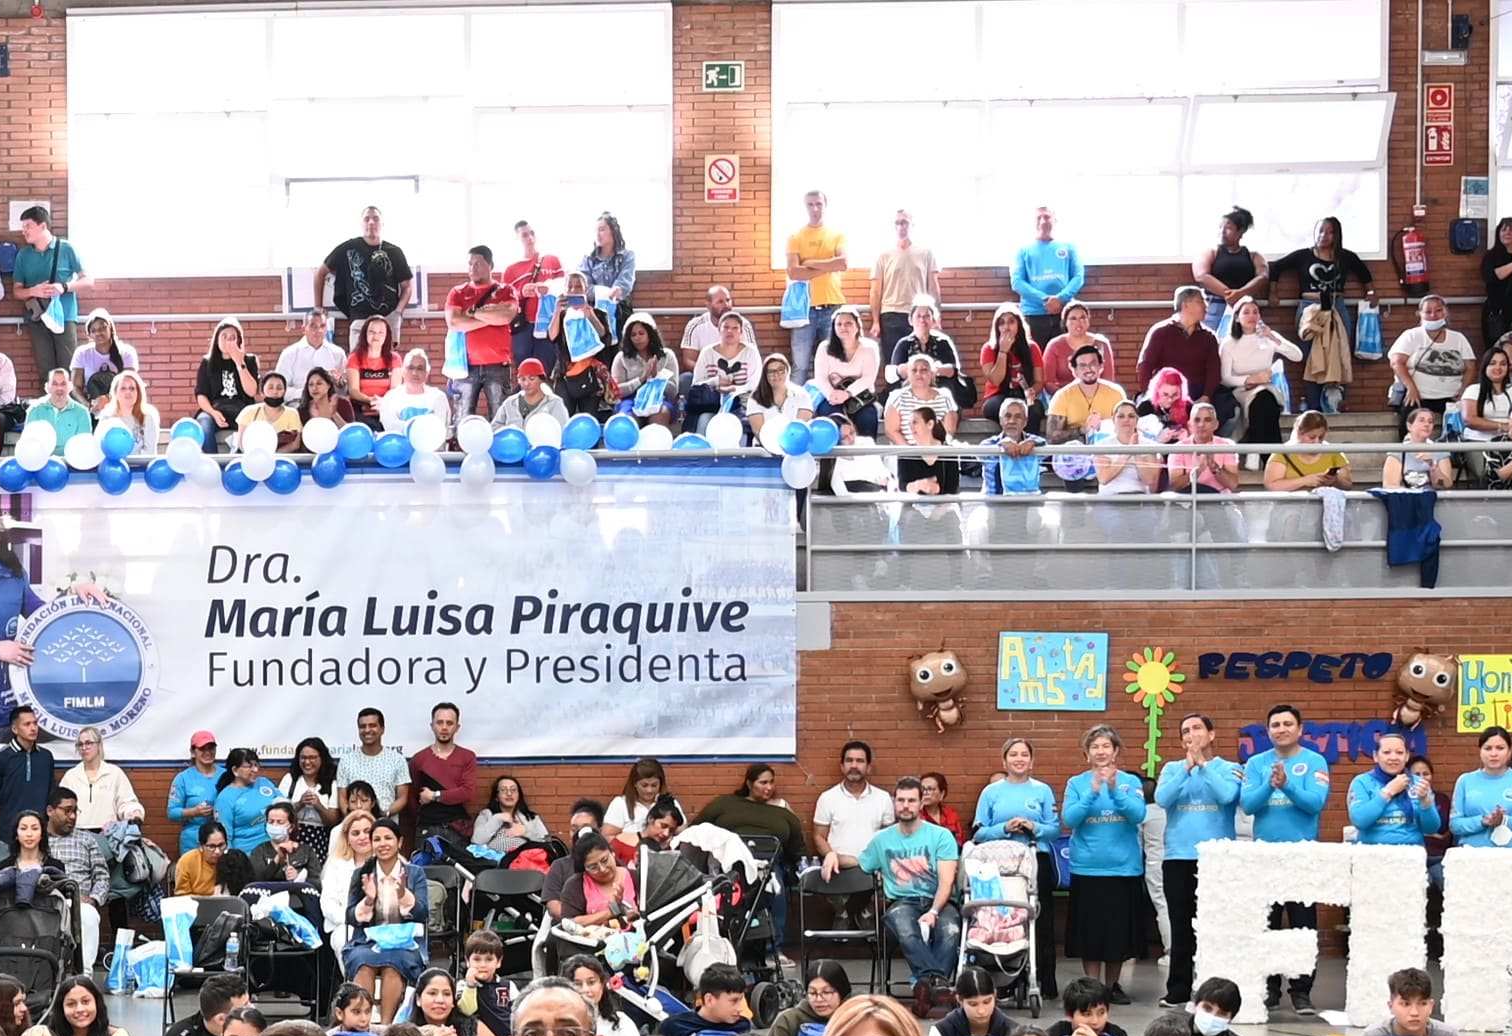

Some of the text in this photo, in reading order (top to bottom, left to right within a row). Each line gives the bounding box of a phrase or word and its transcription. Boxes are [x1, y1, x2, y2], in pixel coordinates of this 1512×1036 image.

[207, 545, 301, 584] Dra.
[205, 586, 749, 643] María Luisa Piraquive
[209, 644, 747, 694] Fundadora y Presidenta
[1198, 651, 1394, 684] RESPETO
[63, 696, 105, 708] FIMLM
[110, 687, 152, 731] MORENO
